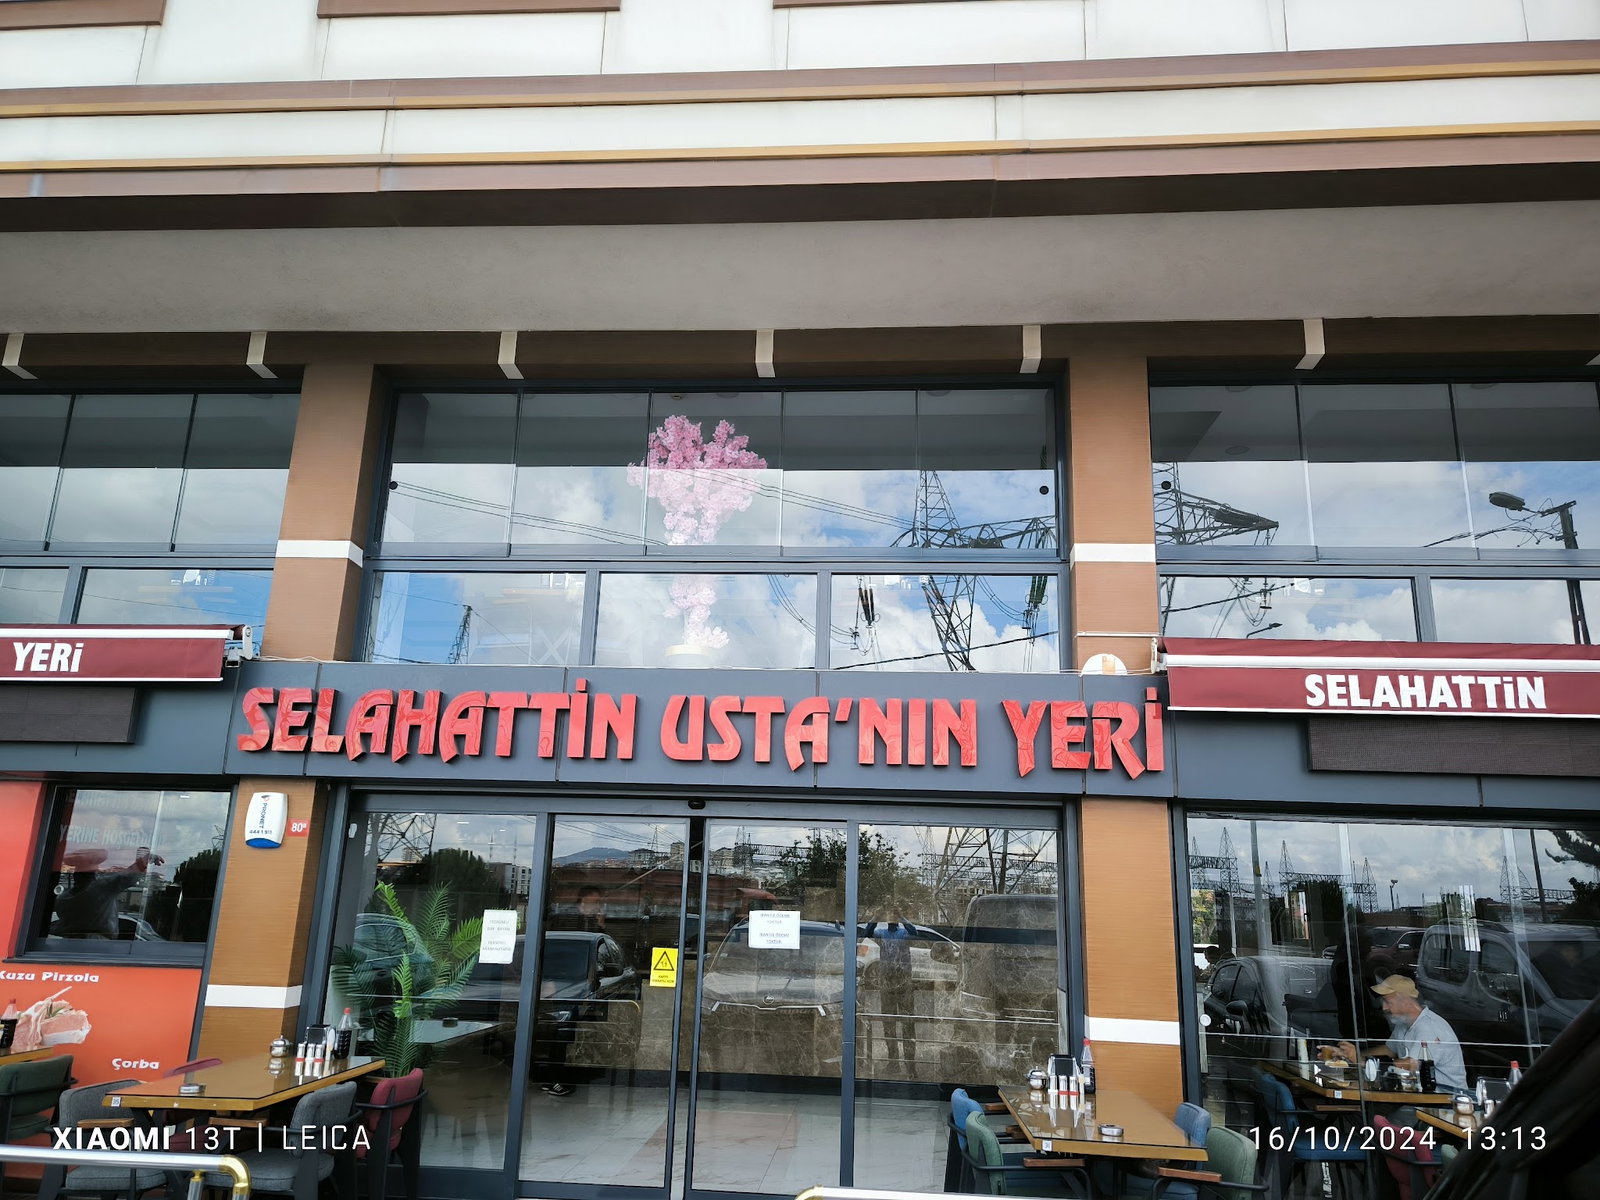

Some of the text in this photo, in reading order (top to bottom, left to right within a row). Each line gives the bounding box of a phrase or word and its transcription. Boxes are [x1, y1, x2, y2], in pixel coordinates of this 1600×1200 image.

[237, 677, 1164, 780] SELAHATTİN USTA'NIN YERİ
[42, 971, 99, 983] Pirzola
[112, 1058, 160, 1071] Çorba
